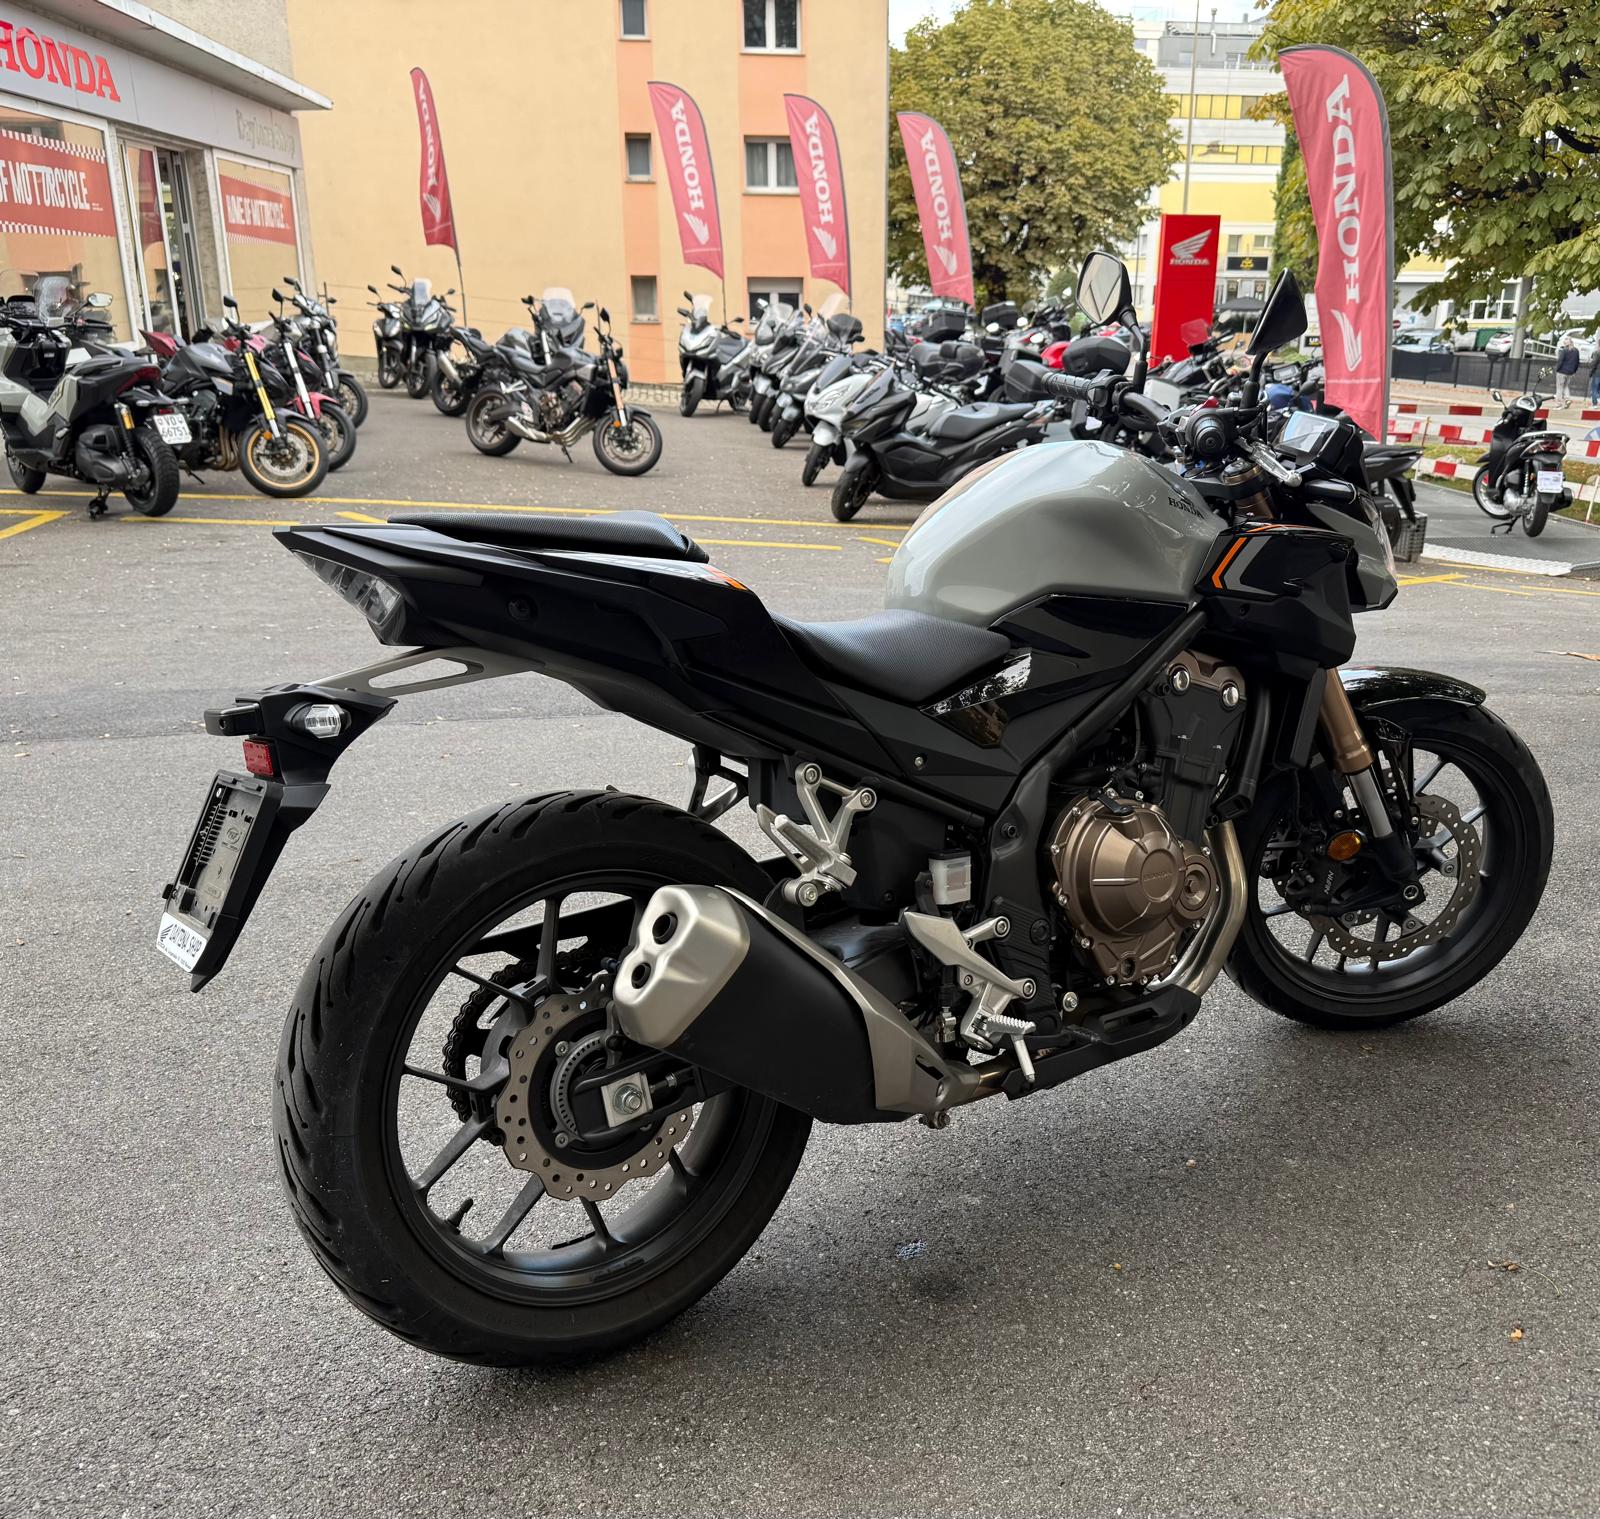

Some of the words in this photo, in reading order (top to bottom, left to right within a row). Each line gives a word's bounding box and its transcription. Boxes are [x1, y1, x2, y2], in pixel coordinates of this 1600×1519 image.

[0, 20, 121, 102] HONDA
[419, 78, 438, 188] HONDA
[671, 98, 704, 211] HONDA
[804, 111, 834, 225] HONDA
[920, 126, 953, 242] HONDA
[1326, 74, 1360, 304] HONDA
[1169, 258, 1210, 266] HONDA
